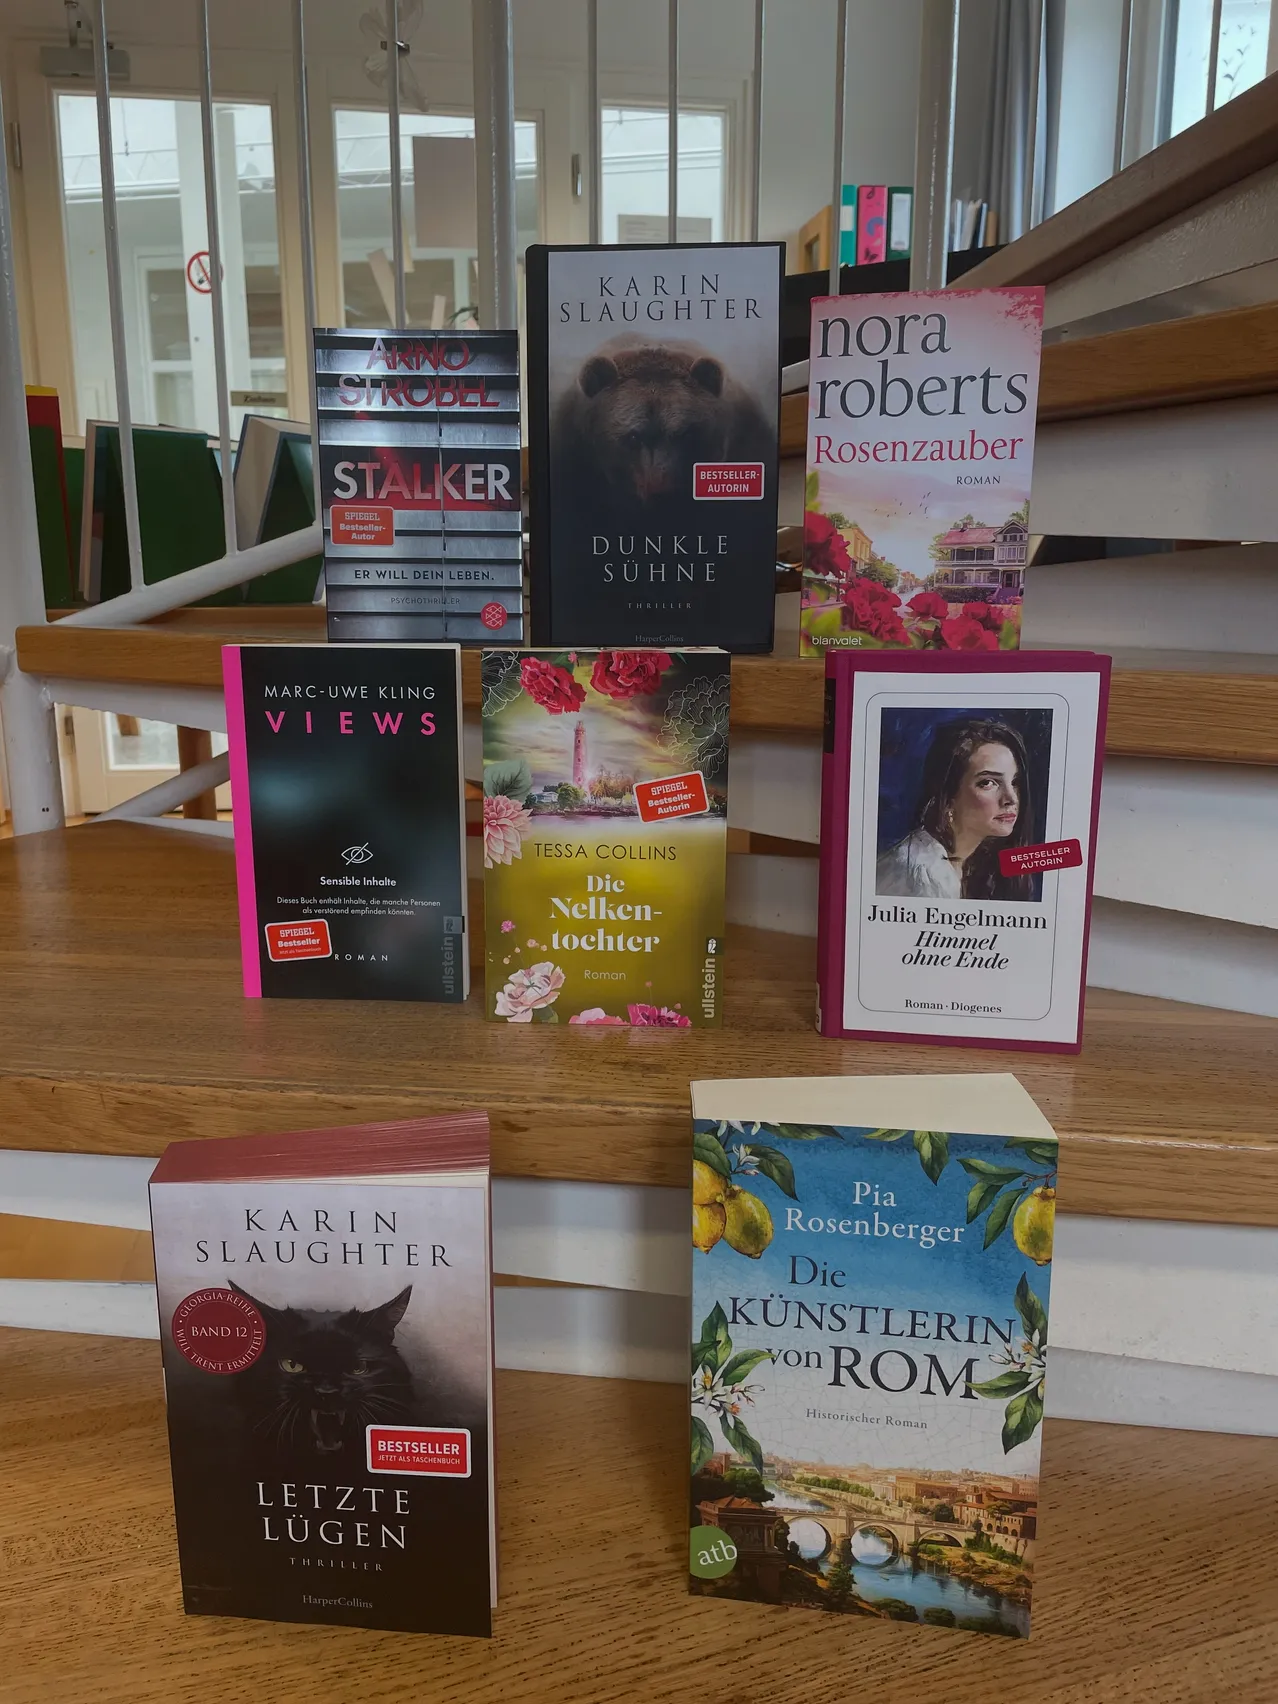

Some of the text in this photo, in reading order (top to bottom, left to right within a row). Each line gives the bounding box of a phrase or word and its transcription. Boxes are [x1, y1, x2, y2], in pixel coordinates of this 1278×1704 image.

[599, 273, 719, 297] KARIN
[560, 299, 762, 323] SLAUGHTER
[817, 312, 951, 358] nora
[366, 337, 470, 371] ARNO
[338, 373, 500, 407] STROBEL
[815, 359, 1028, 420] roberts
[814, 430, 1023, 464] Rosenzauber
[333, 460, 513, 501] STALKER
[700, 470, 760, 480] BESTSELLER-
[956, 475, 1001, 485] ROMAN
[707, 484, 749, 493] AUTORIN
[344, 511, 380, 521] SPIEGEL
[340, 523, 386, 532] Bestseller-
[351, 532, 376, 540] Autor
[592, 535, 728, 556] DUNKLE
[354, 569, 495, 581] ER WILL DEIN LEBEN.
[603, 559, 716, 582] SÜHNE
[635, 634, 684, 644] HarperCollins
[811, 635, 862, 646] blanvalet
[264, 685, 436, 700] MARC-UWE KLING
[264, 711, 436, 736] VIEWS
[651, 781, 688, 796] SPIEGEL
[648, 793, 696, 807] Bestseller-
[658, 802, 690, 815] Autorin
[534, 843, 677, 861] TESSA COLLINS
[1010, 847, 1071, 862] BESTSELLER
[1020, 857, 1063, 870] AUTORIN
[320, 876, 397, 887] Sensible Inhalte
[587, 874, 625, 893] Die
[276, 897, 299, 905] Dieses
[300, 897, 317, 905] Buch
[319, 897, 342, 905] enthält
[343, 898, 368, 906] Inhalte,
[382, 898, 409, 906] manche
[410, 899, 441, 907] Personen
[313, 907, 349, 915] verstörend
[350, 908, 386, 917] empfinden
[549, 896, 663, 921] Nelken-
[867, 904, 1048, 930] Julia Engelmann
[280, 927, 315, 938] SPIEGEL
[552, 928, 660, 953] tochter
[914, 930, 998, 950] Himmel
[277, 938, 321, 948] Bestseller
[334, 953, 389, 962] ROMAN
[441, 936, 455, 995] ullstein
[901, 949, 1009, 970] ohne Ende
[584, 970, 626, 980] Roman
[701, 957, 716, 1019] ullstein
[905, 999, 1002, 1014] Roman Diogenes
[853, 1181, 897, 1207] Pia
[245, 1208, 398, 1234] KARIN
[784, 1207, 965, 1249] Rosenberger
[196, 1240, 453, 1268] SLAUGHTER
[788, 1255, 847, 1288] Die
[180, 1291, 256, 1318] GEORGIA-REIHE
[728, 1293, 1016, 1346] KÜNSTLERIN
[191, 1326, 248, 1338] BAND 12
[176, 1328, 262, 1371] WILL TRENT ERMITTELT
[765, 1345, 981, 1400] von ROM
[806, 1408, 928, 1430] Historischer Roman
[378, 1440, 460, 1455] BESTSELLER
[378, 1454, 461, 1465] JETZT ALS TASCHENBUCH
[256, 1481, 410, 1515] LETZTE
[262, 1514, 406, 1549] LÜGEN
[697, 1539, 738, 1566] atb
[289, 1557, 383, 1572] THRILLER
[302, 1594, 373, 1609] HarperCollins
